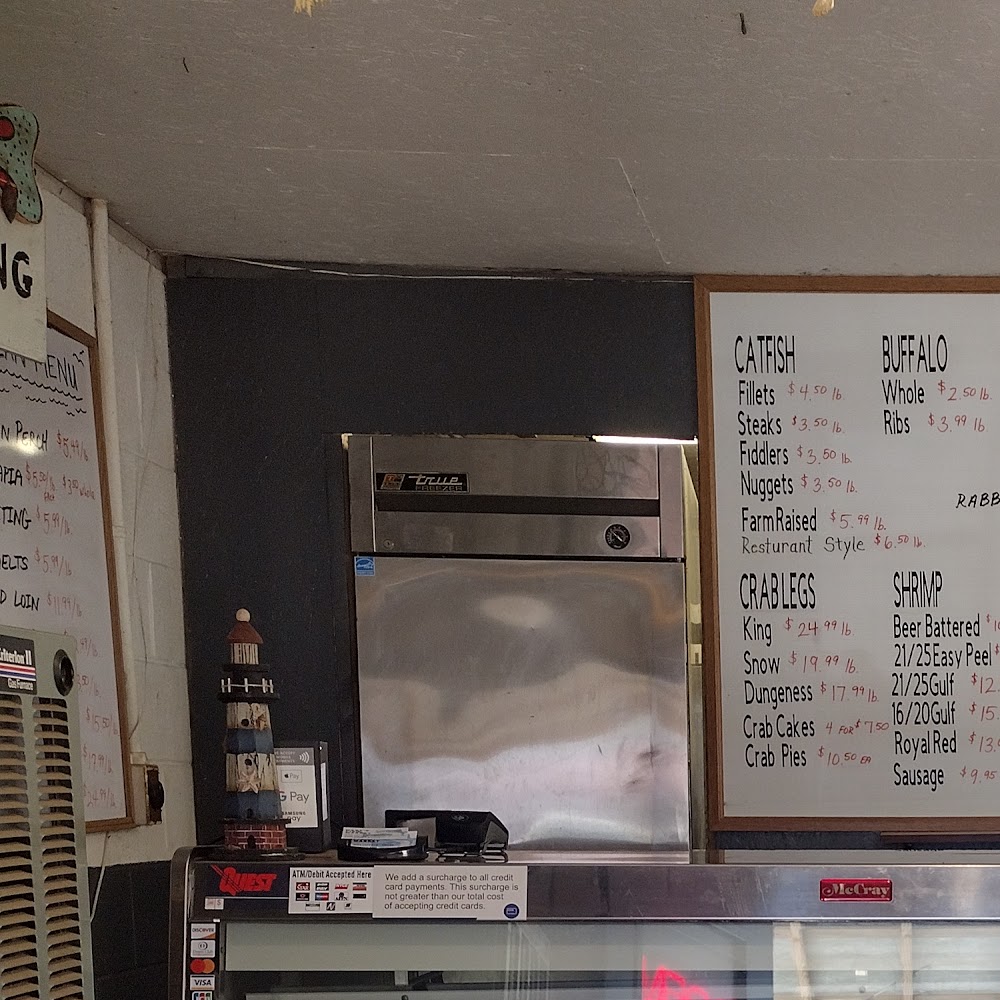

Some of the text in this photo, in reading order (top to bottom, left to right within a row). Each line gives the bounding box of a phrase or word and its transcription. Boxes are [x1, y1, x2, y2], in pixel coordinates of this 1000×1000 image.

[734, 335, 796, 374] CATFISH
[881, 334, 949, 374] BUFFALO
[738, 380, 776, 406] Fillets
[881, 379, 926, 406] Whole
[737, 411, 783, 437] Steaks
[883, 409, 911, 436] Ribs
[739, 440, 790, 466] Fiddlers
[740, 470, 794, 502] Nuggets
[823, 535, 866, 560] Style
[893, 570, 943, 608] SHRIMP
[742, 616, 773, 647] King
[893, 612, 981, 639] Beer Battered
[743, 650, 781, 676] Snow
[893, 642, 992, 669] 21/25 Easy Peel
[744, 679, 813, 710] Dungeness
[742, 714, 816, 740] Crab Cakes
[745, 743, 807, 768] Crab Pies
[894, 731, 931, 761] Royal
[931, 730, 957, 754] Red
[893, 762, 945, 791] Sausage
[290, 791, 310, 804] Pay
[292, 869, 372, 880] ATM/Debit Accepted Here
[385, 873, 514, 884] We add a surcharge to all credit
[384, 883, 519, 893] card payments. This surcharge is
[384, 893, 398, 901] not
[399, 893, 430, 903] greater
[430, 893, 451, 901] than
[466, 893, 484, 901] total
[485, 893, 504, 901] cost
[821, 882, 891, 899] McCray
[384, 902, 486, 912] of accepting credit cards.
[193, 979, 213, 987] VISA
